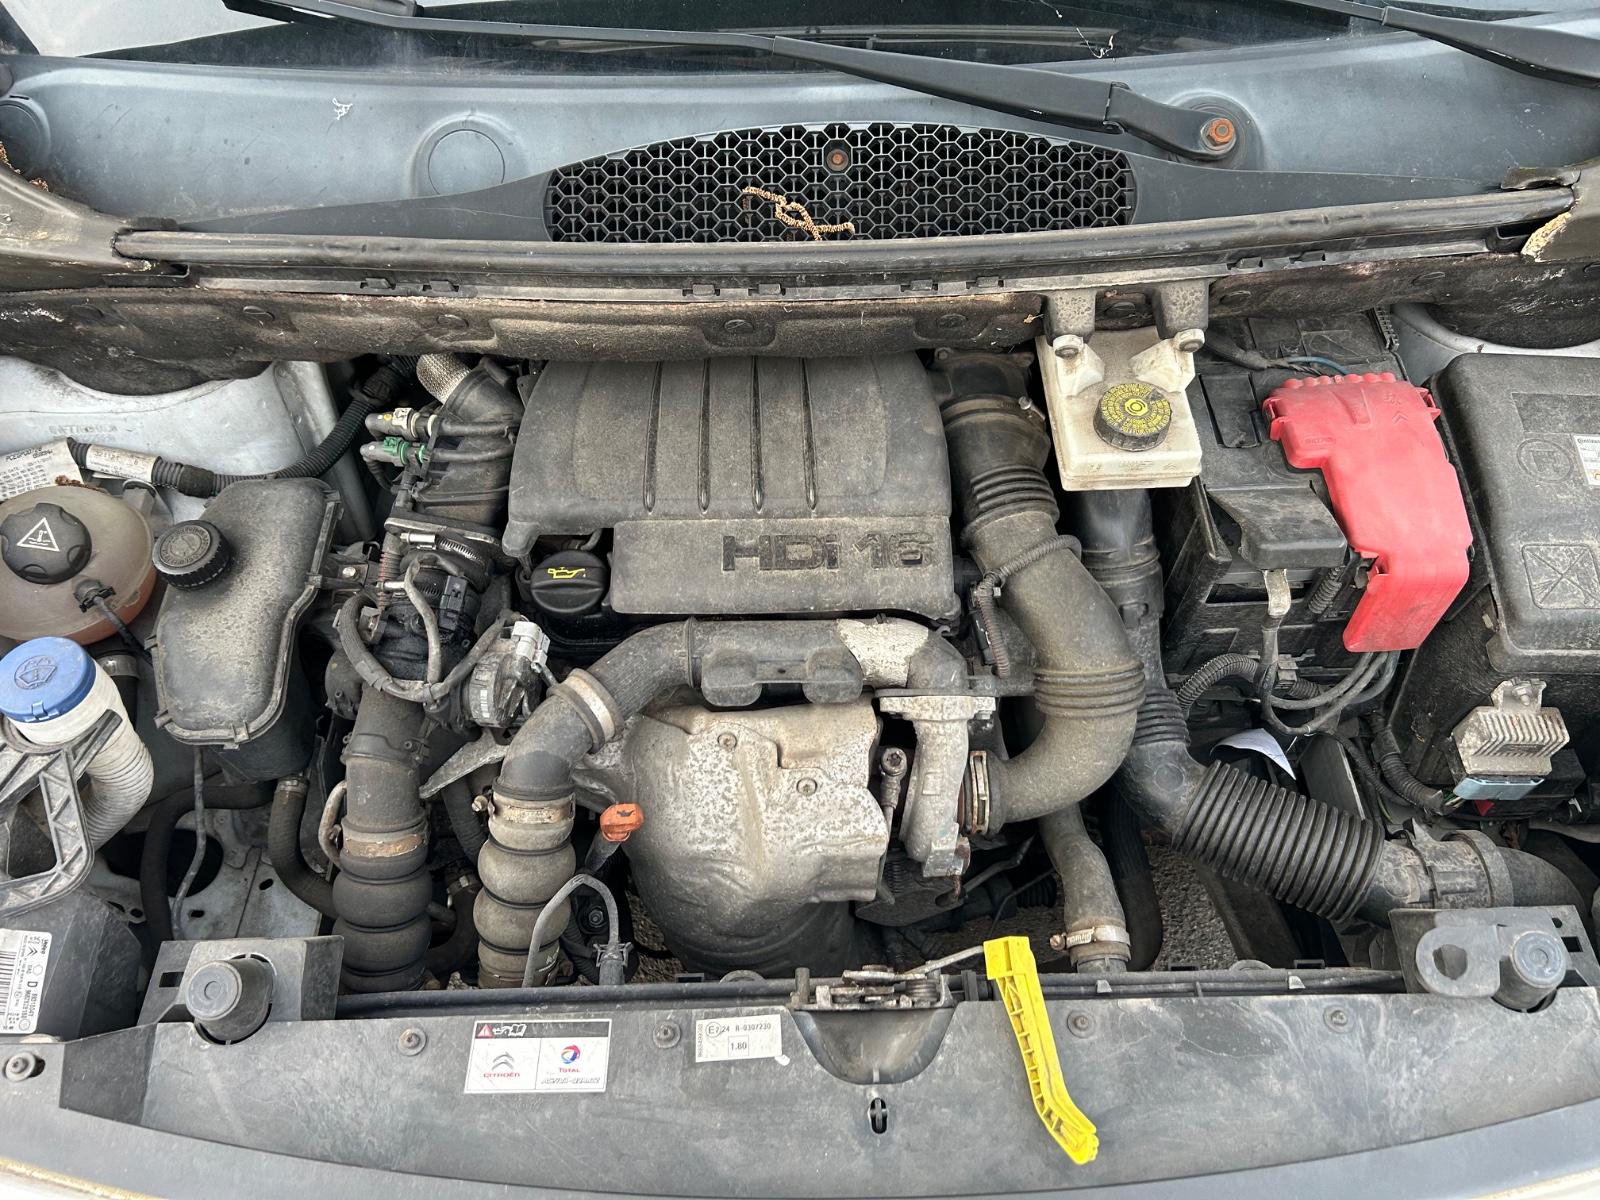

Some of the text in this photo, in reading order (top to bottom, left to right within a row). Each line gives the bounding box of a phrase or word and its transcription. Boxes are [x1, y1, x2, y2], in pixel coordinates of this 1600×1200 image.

[722, 531, 933, 572] HDi 16
[731, 1041, 748, 1051] 1.80
